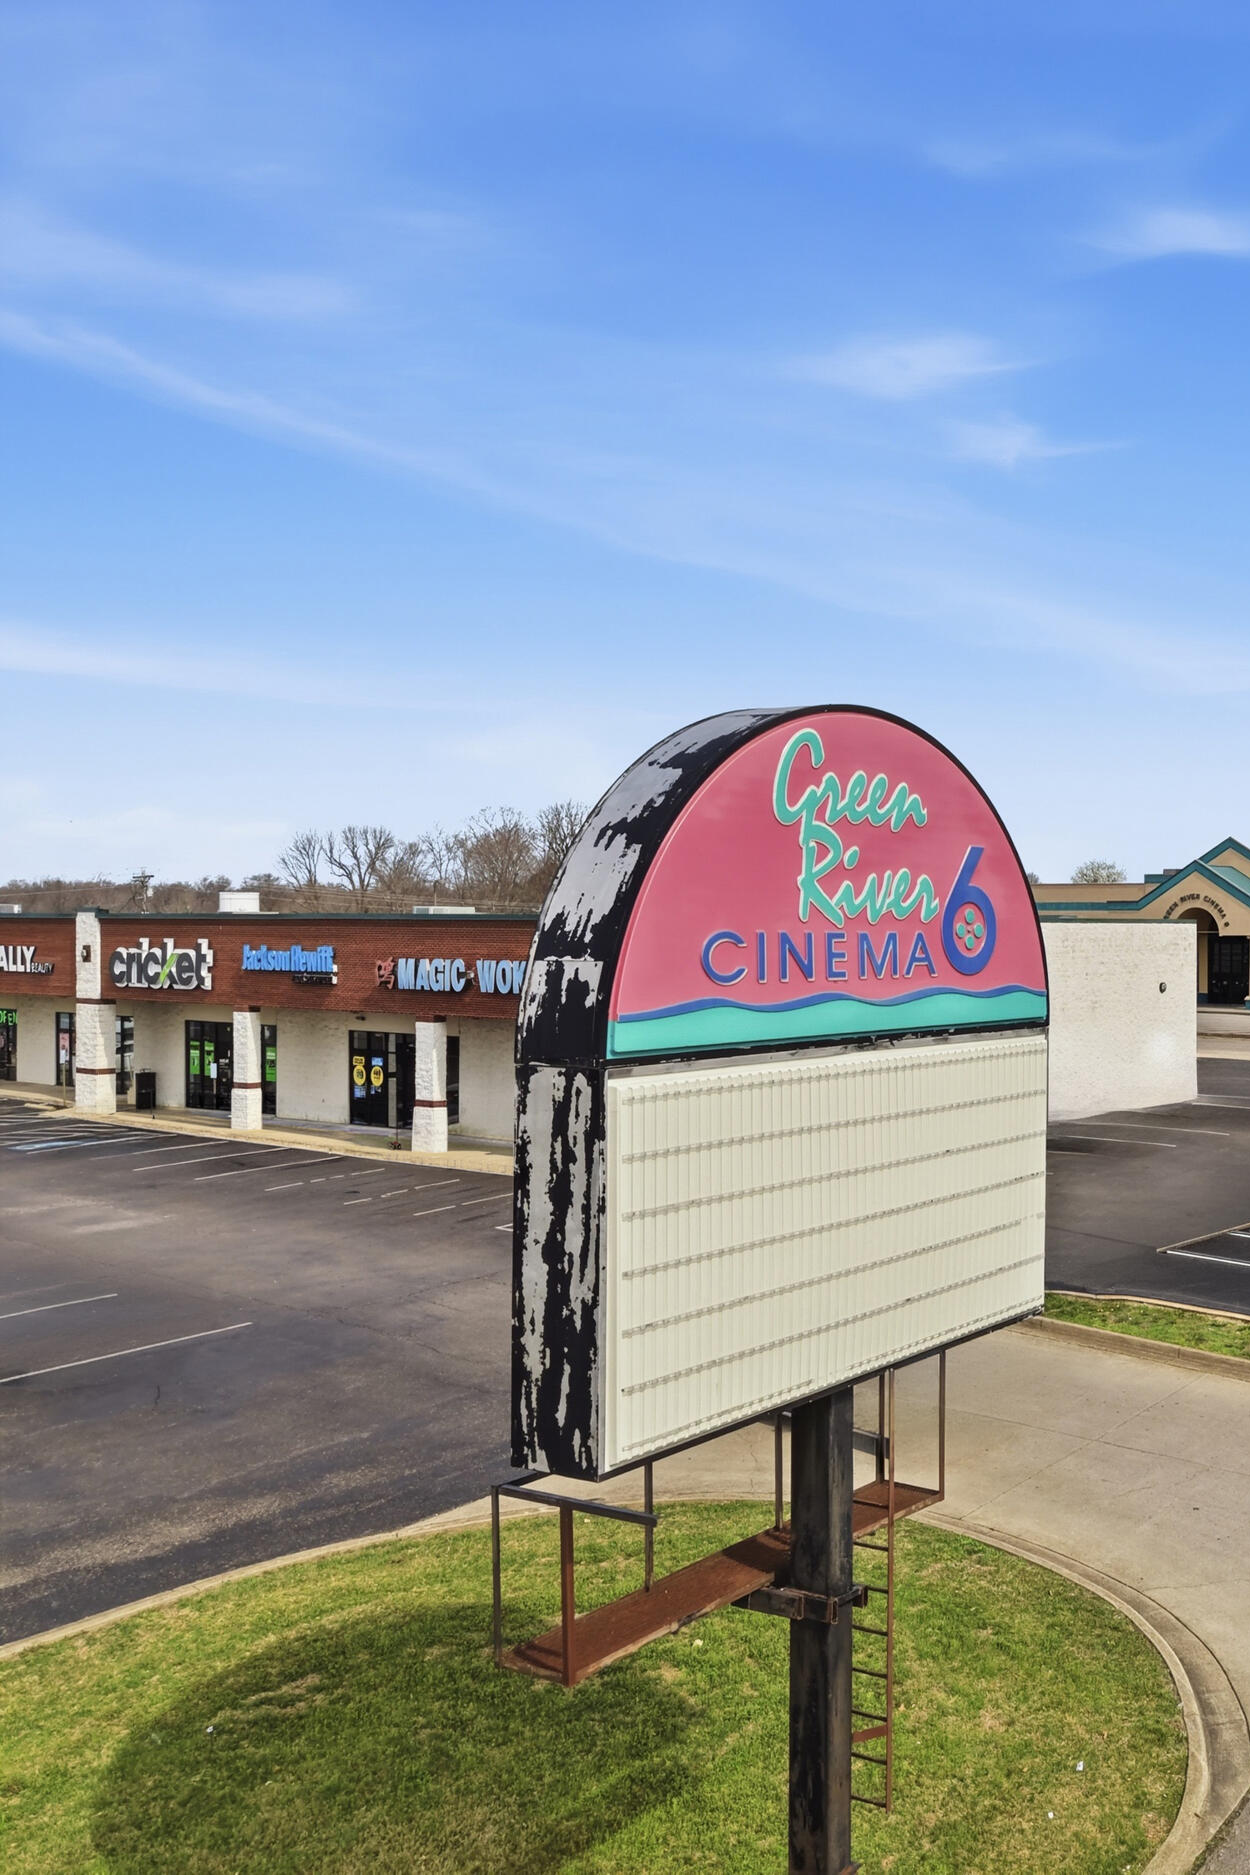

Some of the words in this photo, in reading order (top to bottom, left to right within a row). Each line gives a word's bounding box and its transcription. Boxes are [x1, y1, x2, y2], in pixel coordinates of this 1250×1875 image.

[773, 728, 928, 832] Green
[797, 821, 940, 927] River
[702, 929, 939, 985] CINEMA
[941, 845, 997, 976] 6
[1180, 893, 1201, 903] RIVER
[1203, 895, 1227, 919] CINEMA
[109, 938, 213, 990] cricket
[242, 944, 290, 971] Jackson
[290, 945, 334, 972] Hewitt
[398, 958, 466, 992] MAGIC
[476, 959, 527, 994] WOK
